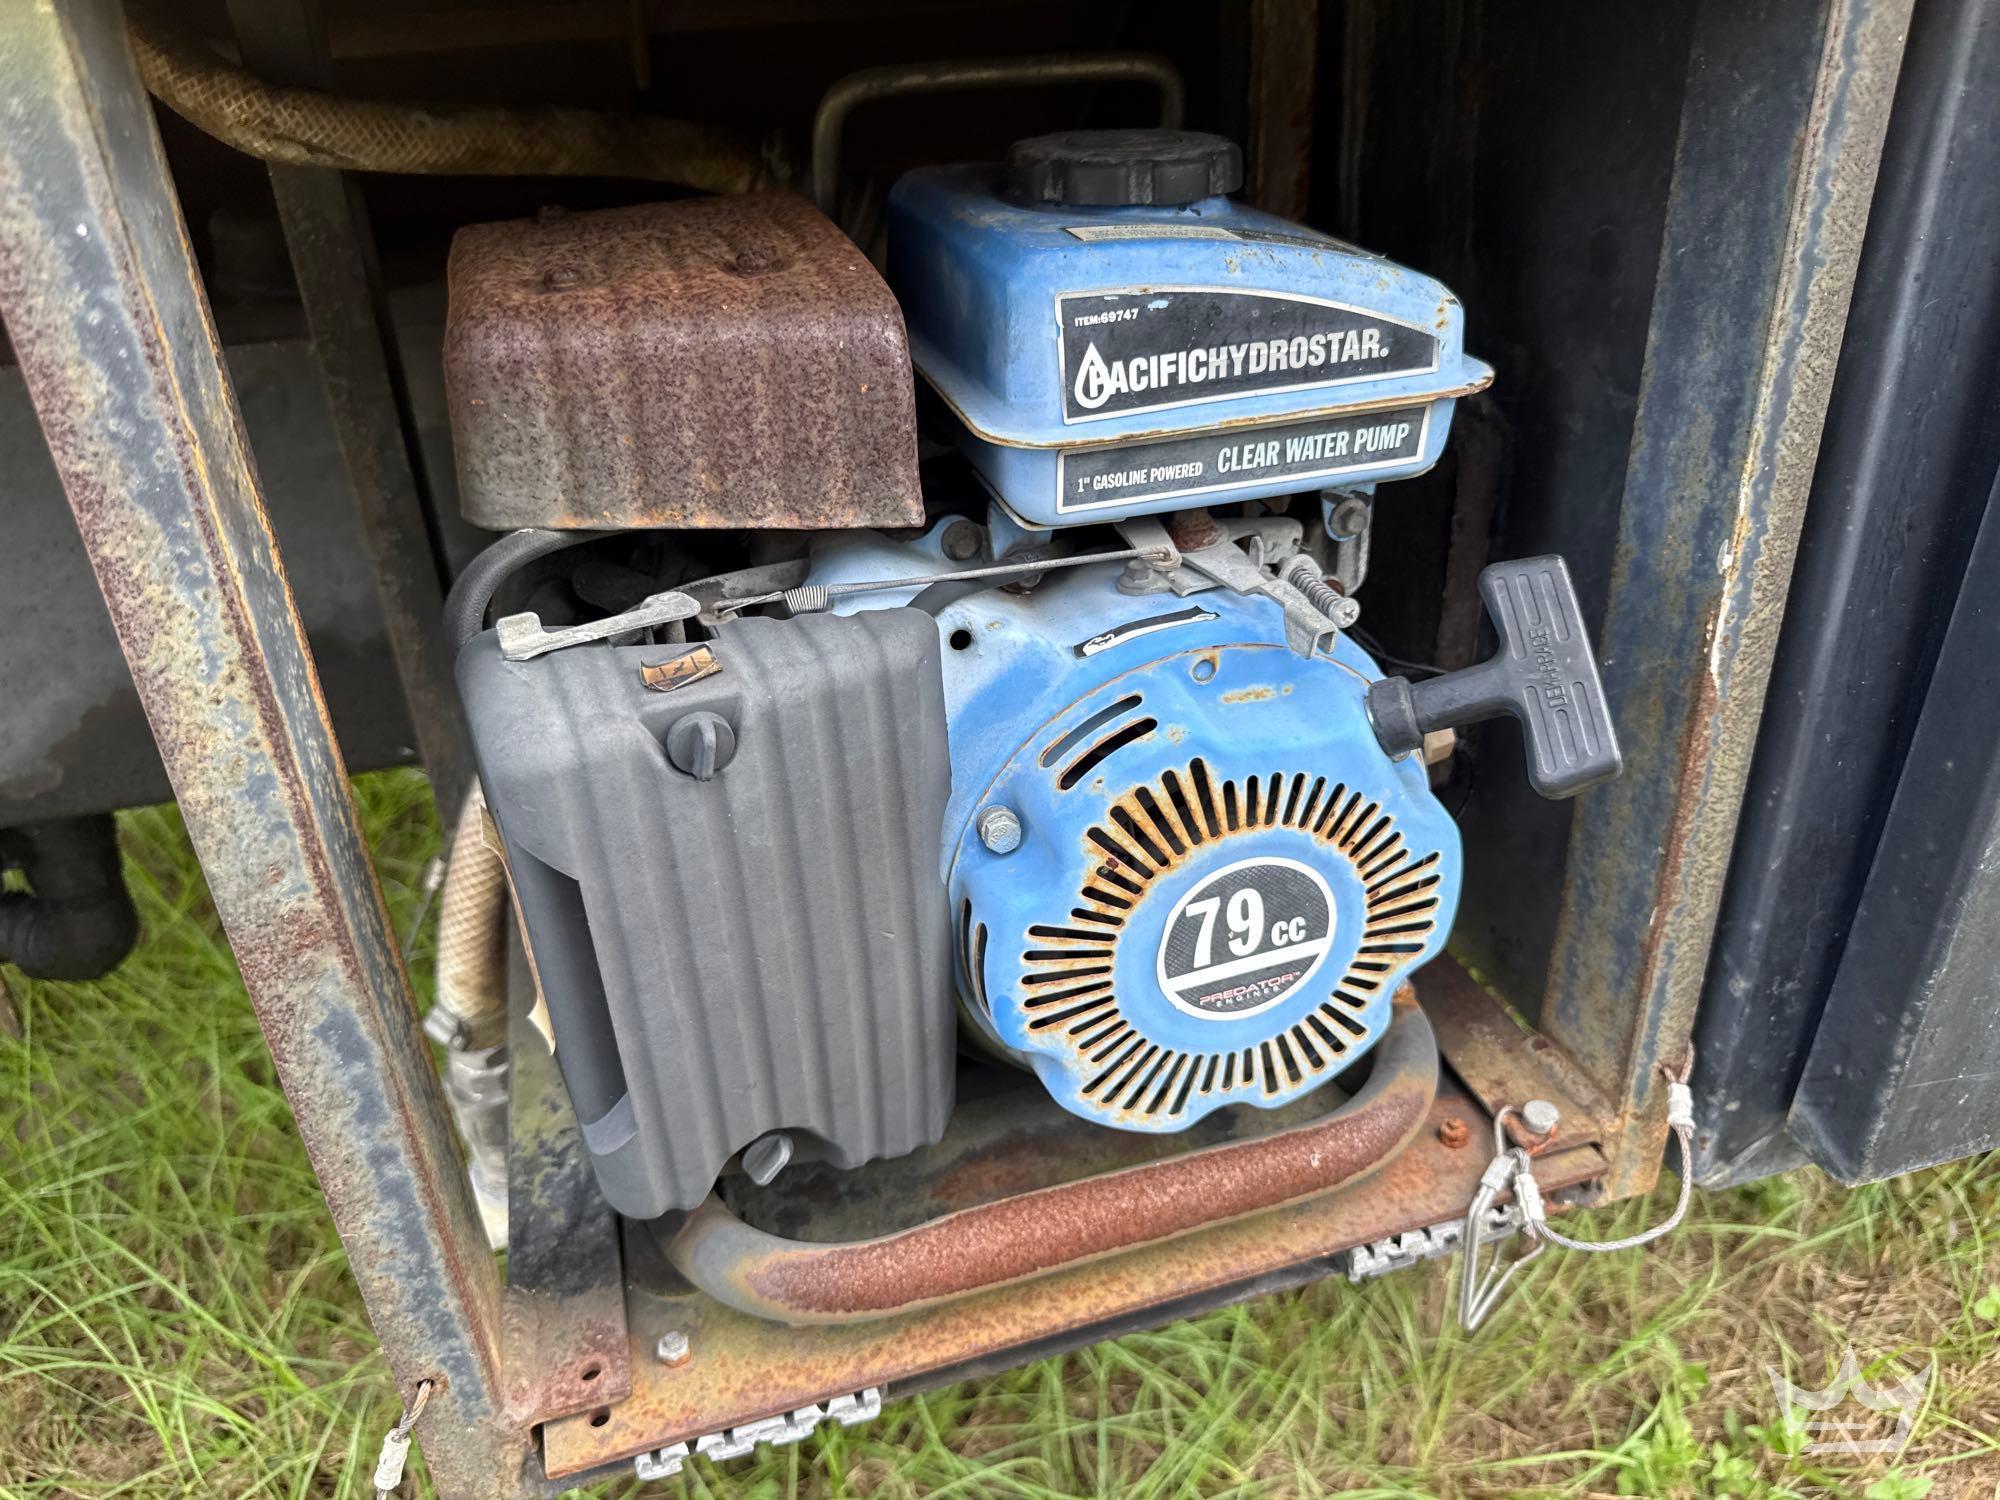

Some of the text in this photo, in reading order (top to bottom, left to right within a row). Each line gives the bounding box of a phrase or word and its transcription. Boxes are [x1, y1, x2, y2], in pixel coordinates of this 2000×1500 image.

[1075, 308, 1139, 327] ITEM:69747
[1093, 469, 1148, 490] GASOLINE
[1150, 462, 1203, 482] POWERED
[1217, 440, 1281, 473] CLEAR
[1286, 431, 1350, 464] WATER
[1354, 423, 1410, 454] PUMP
[1186, 887, 1265, 968] 79
